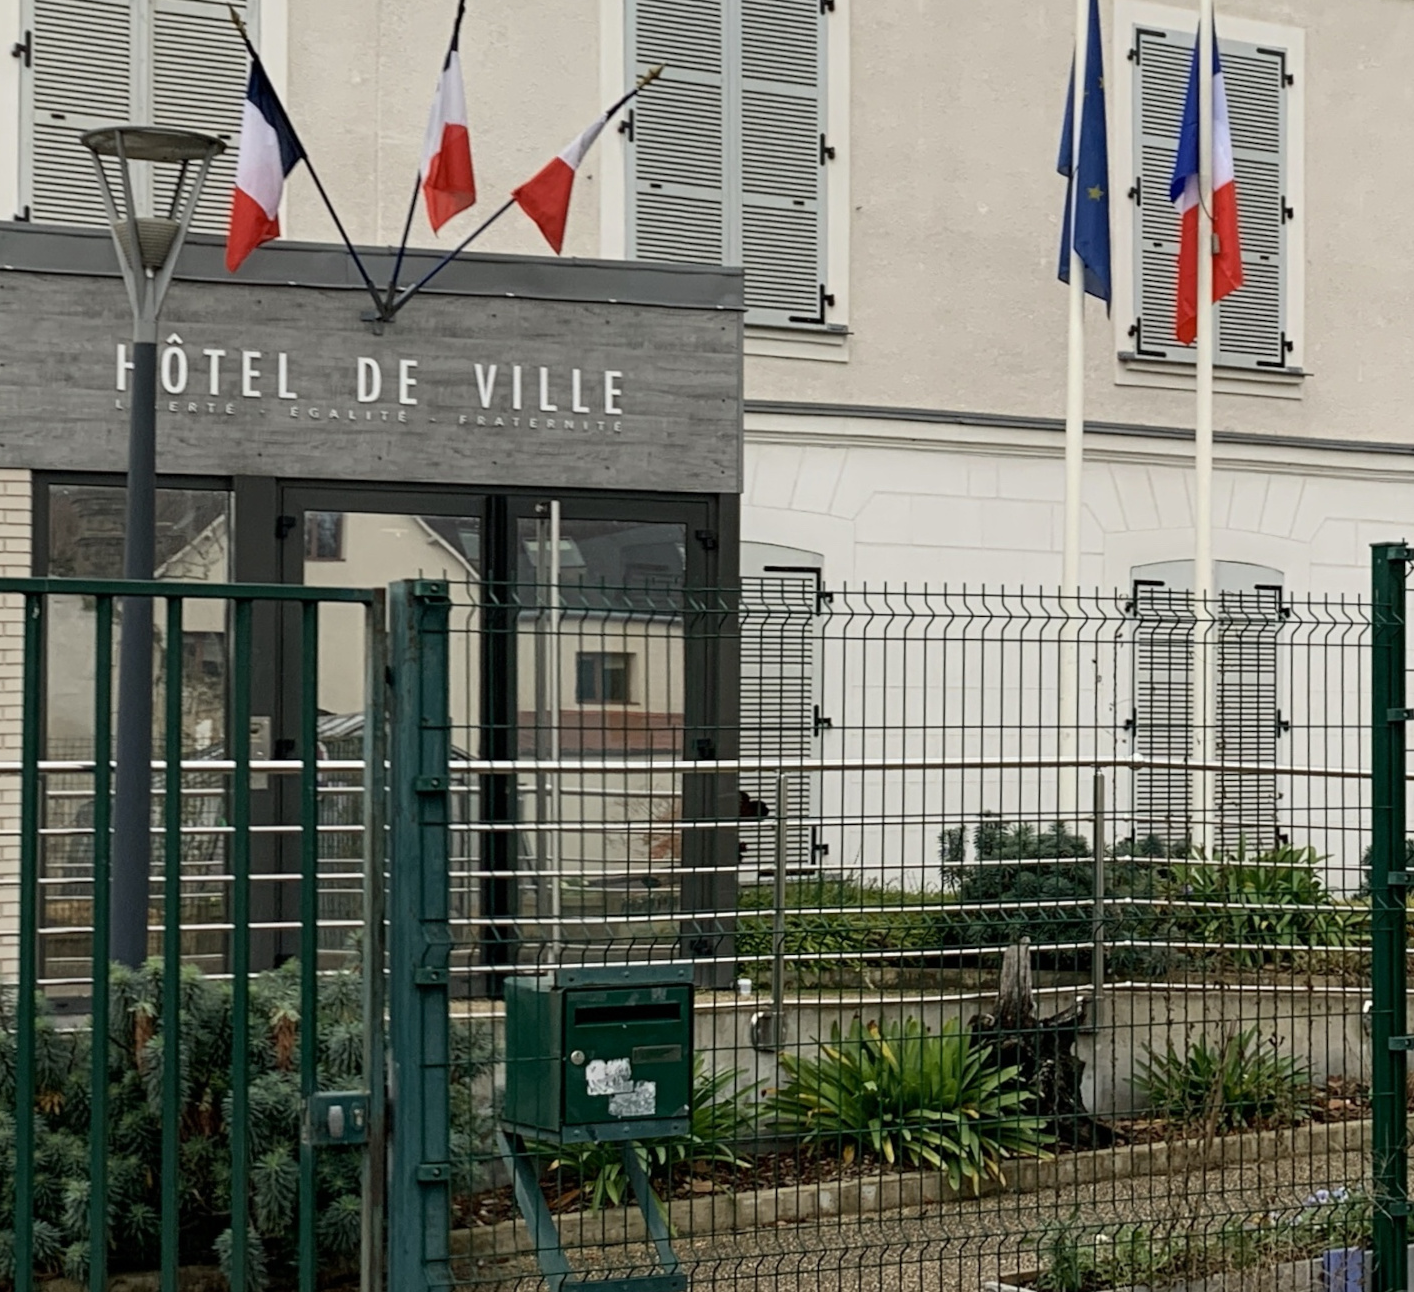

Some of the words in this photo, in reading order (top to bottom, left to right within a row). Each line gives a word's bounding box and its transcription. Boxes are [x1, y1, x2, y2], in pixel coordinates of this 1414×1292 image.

[116, 332, 298, 400] HÔTEL
[356, 356, 419, 405] DE
[473, 363, 623, 415] VILLE
[114, 398, 236, 415] LERTÉ
[289, 406, 407, 422] ÉGALITÉ
[458, 415, 623, 432] FRATERNITÉ
